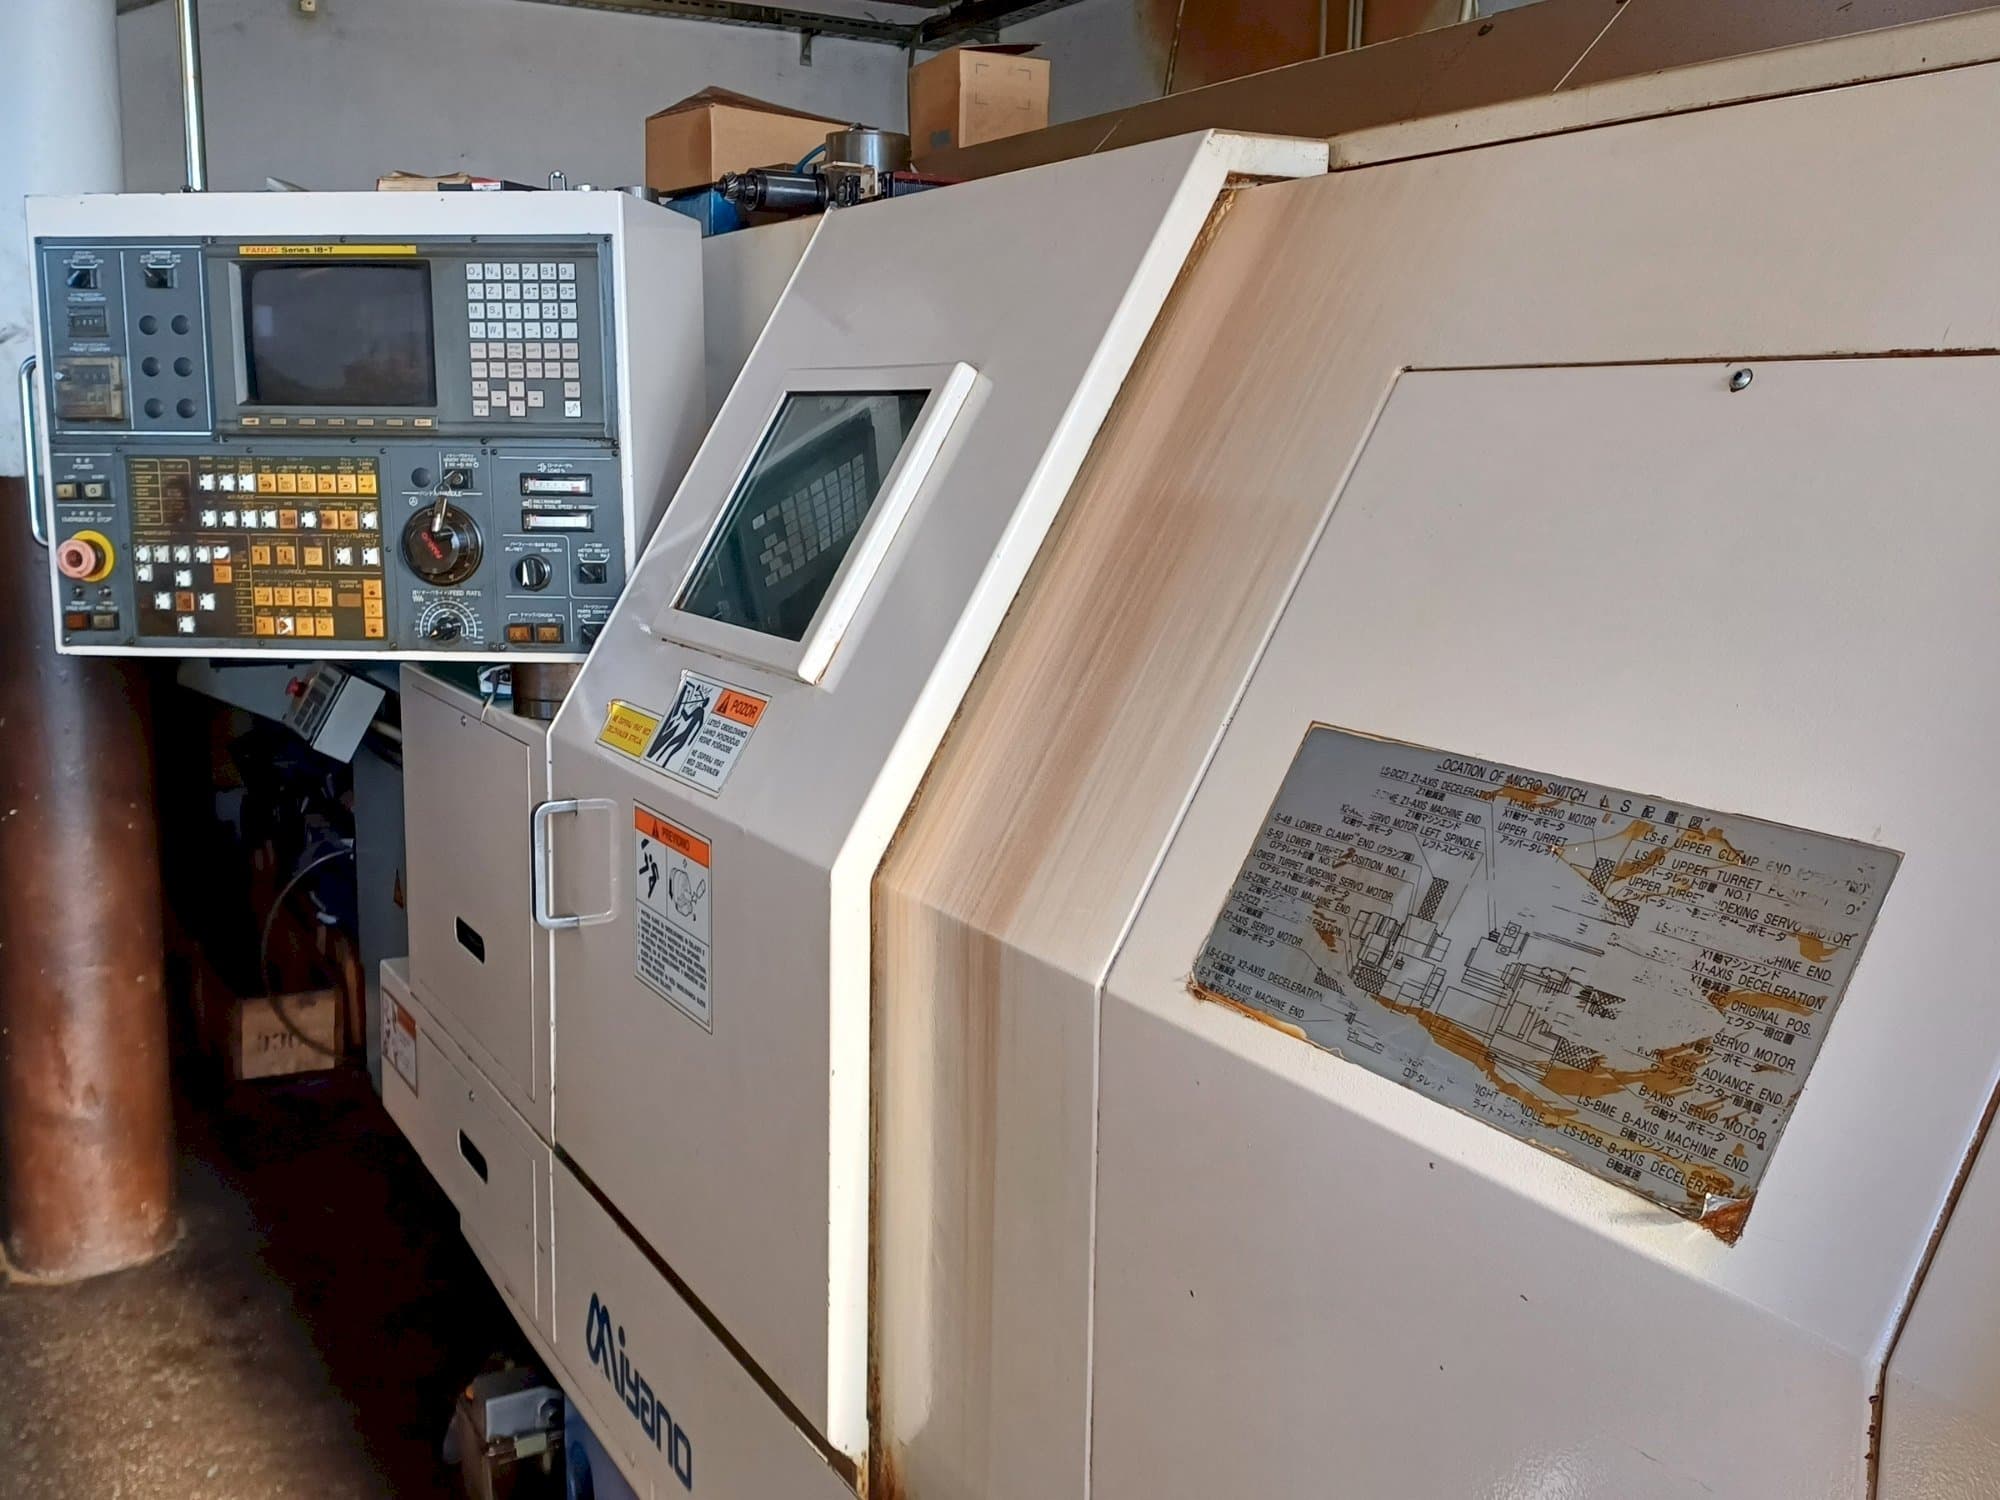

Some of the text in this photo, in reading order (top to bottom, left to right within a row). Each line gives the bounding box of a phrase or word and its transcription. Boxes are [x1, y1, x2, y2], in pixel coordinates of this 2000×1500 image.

[246, 246, 276, 254] FANUC
[281, 246, 310, 254] Series
[728, 698, 759, 720] POZOR
[1409, 772, 1440, 788] Z1-AXIS
[1439, 779, 1498, 803] DECELERATION
[1487, 768, 1506, 784] OF
[1504, 771, 1544, 792] MICRO
[1543, 780, 1590, 803] SWITCH
[1391, 817, 1420, 833] MOTOR
[1399, 795, 1429, 811] Z1-AXIS
[1427, 802, 1464, 820] MACHINE
[1462, 811, 1483, 825] END
[1538, 804, 1566, 820] SERVO
[1566, 811, 1598, 828] MOTOR
[1293, 817, 1324, 834] LOWER
[1323, 826, 1355, 843] CLAMP
[1355, 836, 1376, 850] END
[1418, 824, 1482, 850] LEFT SPINDLE
[1495, 820, 1529, 837] UPPER
[1284, 832, 1312, 849] LOWER
[1349, 853, 1384, 871] OSITION
[1384, 863, 1407, 878] NO.1
[1641, 829, 1670, 846] LS-6
[1671, 837, 1714, 857] UPPER
[1715, 847, 1761, 868] CLAMP
[1251, 847, 1395, 902] LOWER TURRET INDEXING SERVO MOTOR
[1669, 858, 1710, 878] UPPER
[1713, 869, 1763, 891] TURRET
[1299, 889, 1334, 908] MACHINE
[1333, 900, 1352, 914] END
[1626, 875, 1663, 894] UPPER
[1762, 911, 1805, 933] SERVO
[1723, 886, 1753, 903] NO.1
[1249, 919, 1276, 937] SERVO
[1275, 929, 1304, 948] MOTOR
[1236, 958, 1267, 978] X2-AXIS
[1266, 970, 1326, 1002] DECELERATION
[1690, 959, 1735, 982] X1-AXIS
[1736, 973, 1826, 1010] DECELERATION
[1804, 964, 1834, 982] END
[1252, 989, 1287, 1011] MACHINE
[1287, 1004, 1306, 1020] END
[1728, 998, 1815, 1036] ORIGINAL POS.
[1710, 1032, 1797, 1071] SERVO MOTOR
[1700, 1065, 1756, 1095] ADVANCE
[1757, 1086, 1785, 1106] END
[1637, 1084, 1768, 1144] B-AXIS SERVO MOTOR
[1561, 1122, 1646, 1167] LS-DCB B-AXIS
[1575, 1092, 1751, 1173] LS-BME B-AXIS MACHINE END
[586, 1292, 692, 1491] Miyano
